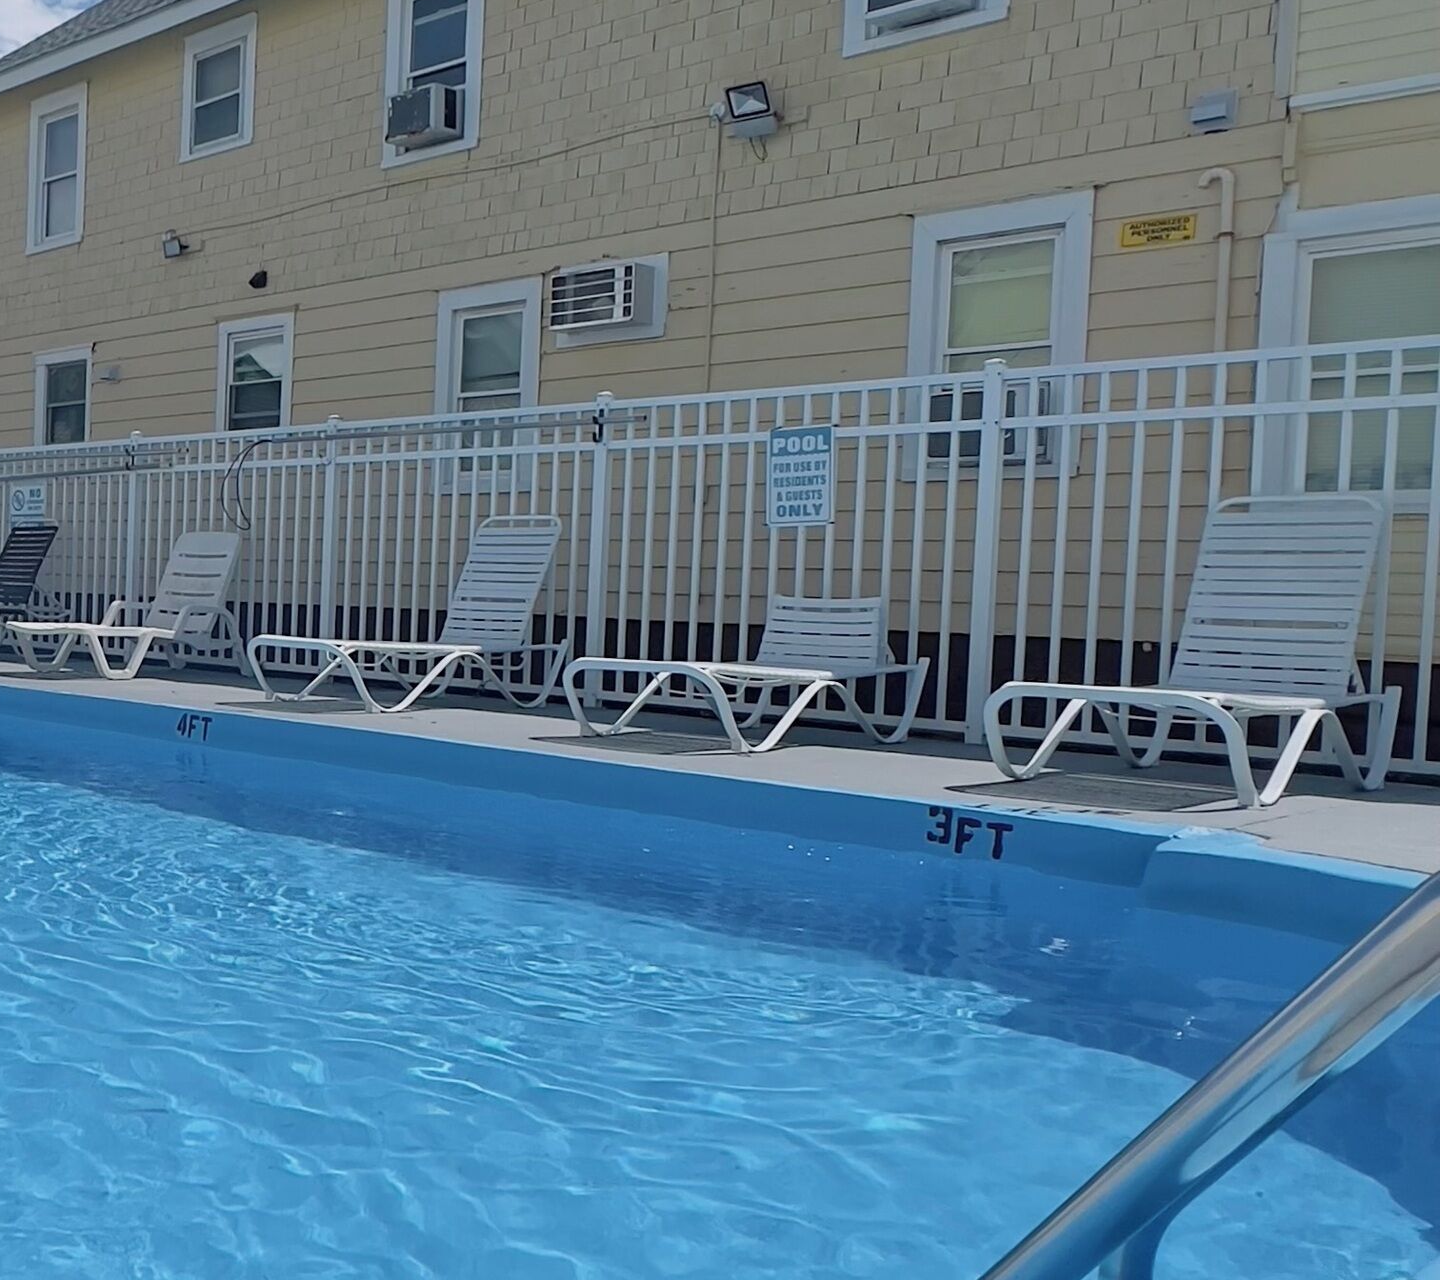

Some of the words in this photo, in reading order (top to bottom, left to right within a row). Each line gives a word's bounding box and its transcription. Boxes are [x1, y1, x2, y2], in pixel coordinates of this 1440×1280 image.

[1129, 216, 1191, 230] AUTHORIZED
[1131, 224, 1189, 237] PERSONNEL
[772, 434, 830, 455] POOL
[773, 462, 792, 473] FOR
[793, 461, 812, 472] USE
[814, 460, 827, 471] BY
[773, 474, 827, 488] RESIDENTS
[29, 488, 41, 498] NO
[785, 489, 823, 502] GUESTS
[776, 503, 823, 518] ONLY
[177, 713, 213, 741] 4FT
[926, 805, 1014, 860] 3FT
